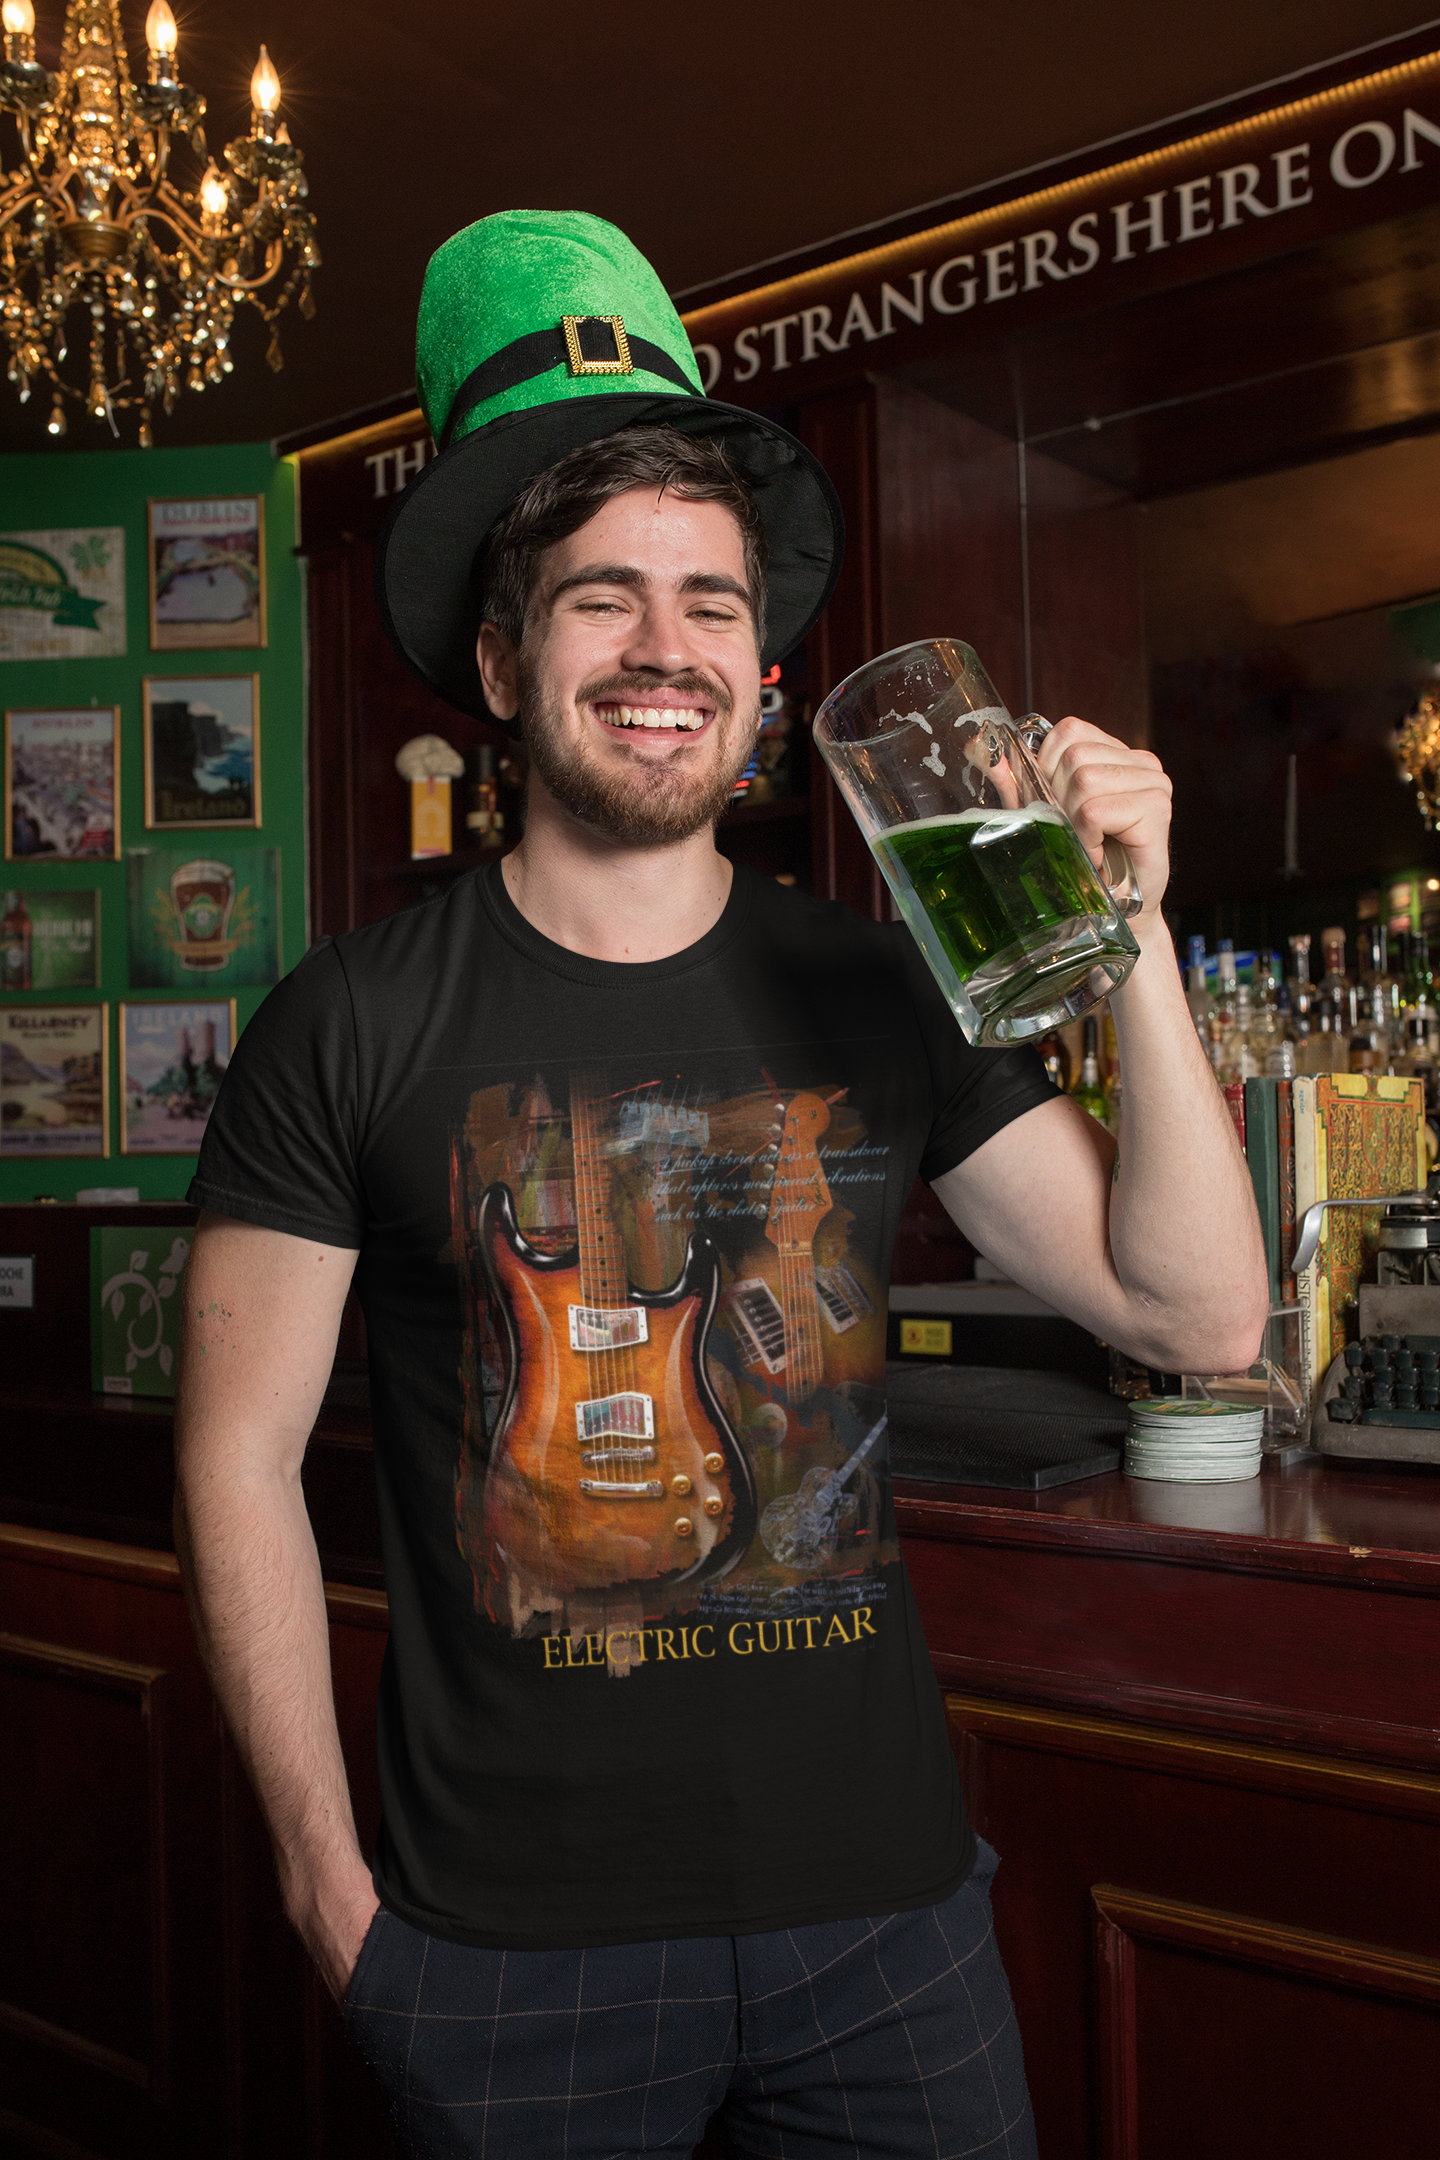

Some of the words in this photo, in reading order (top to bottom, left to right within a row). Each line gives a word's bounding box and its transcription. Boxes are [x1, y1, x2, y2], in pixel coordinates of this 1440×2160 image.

[733, 212, 1101, 383] STRANGERS
[1109, 142, 1314, 264] HERE
[818, 1140, 890, 1159] transducer
[819, 1166, 887, 1184] vibrations
[655, 1202, 686, 1221] such
[686, 1210, 700, 1219] as
[541, 1624, 717, 1669] ELECTRIC
[728, 1606, 879, 1656] GUITAR
